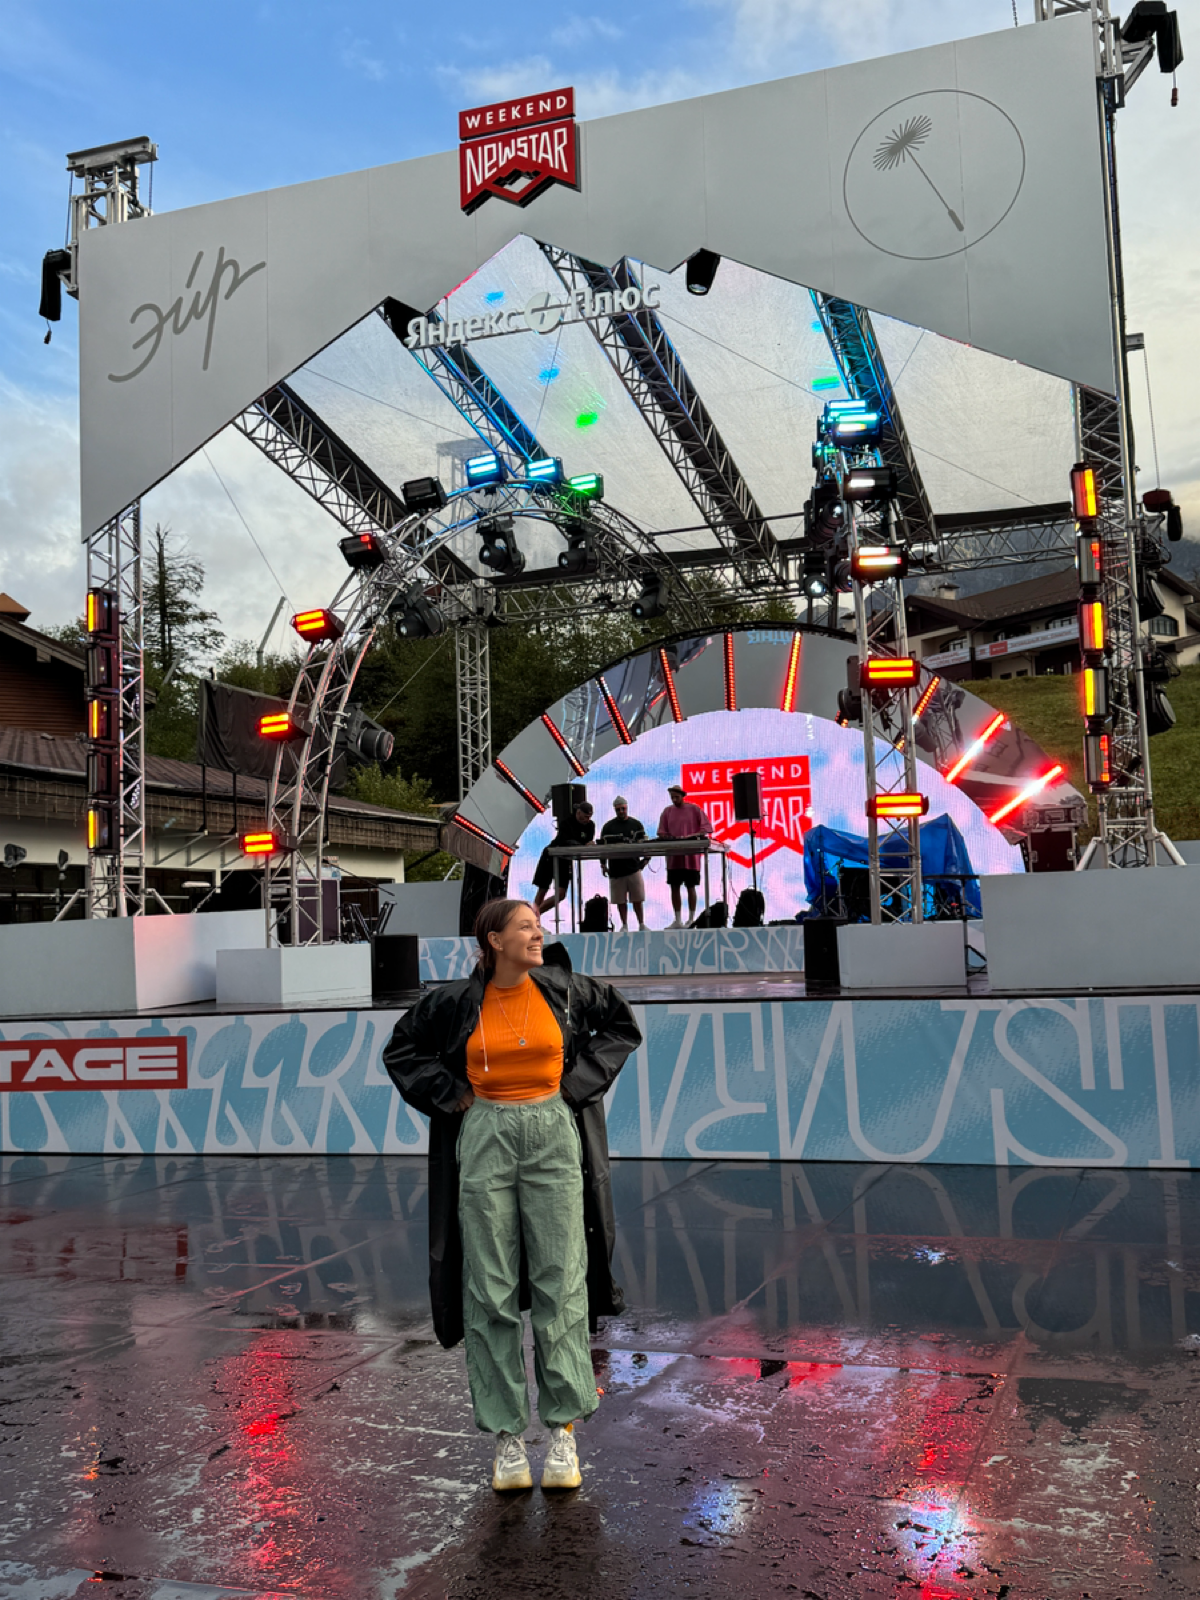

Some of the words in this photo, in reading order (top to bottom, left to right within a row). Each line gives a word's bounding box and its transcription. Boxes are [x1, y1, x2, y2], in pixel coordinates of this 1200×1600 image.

[465, 96, 568, 129] WEEKEND
[404, 309, 519, 349] Яндекс
[570, 284, 660, 321] Плюс
